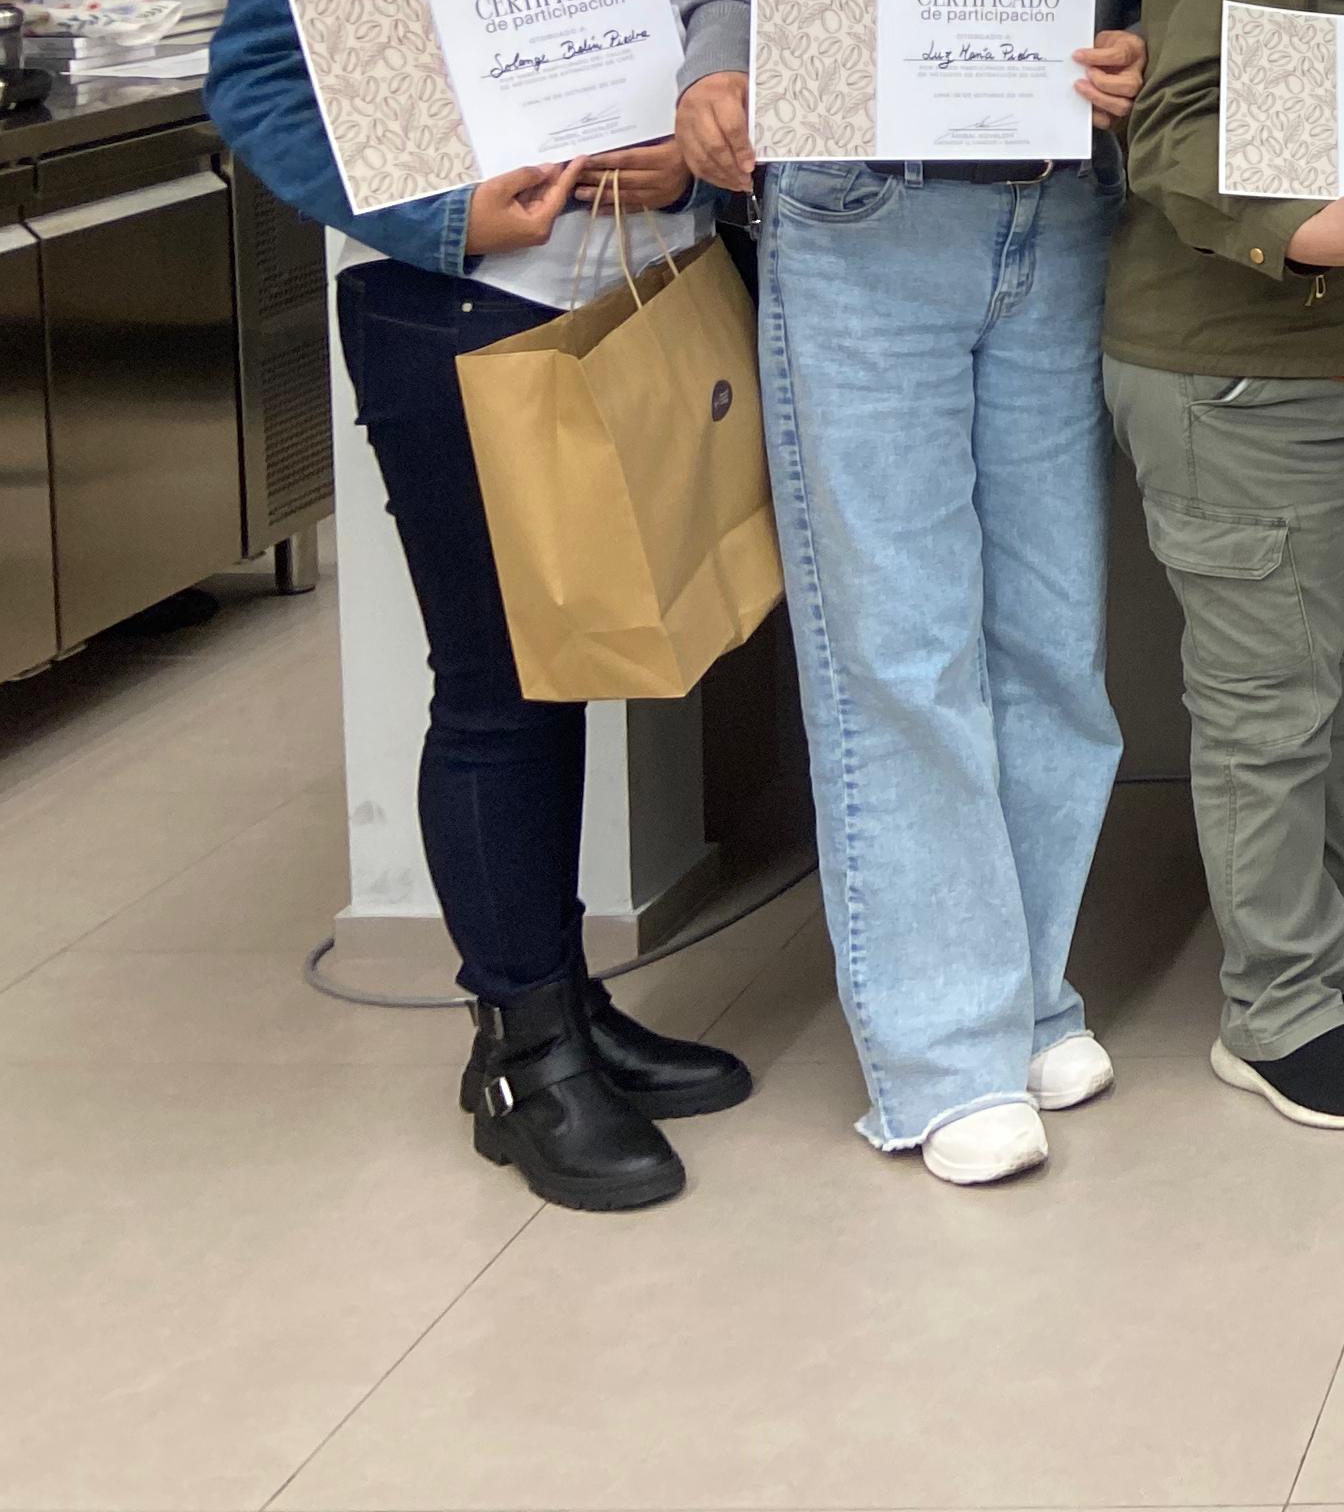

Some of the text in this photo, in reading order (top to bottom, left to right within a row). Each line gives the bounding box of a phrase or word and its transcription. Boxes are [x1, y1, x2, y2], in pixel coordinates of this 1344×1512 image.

[921, 7, 1055, 24] de participación
[485, 16, 509, 34] de
[922, 40, 954, 69] Luz
